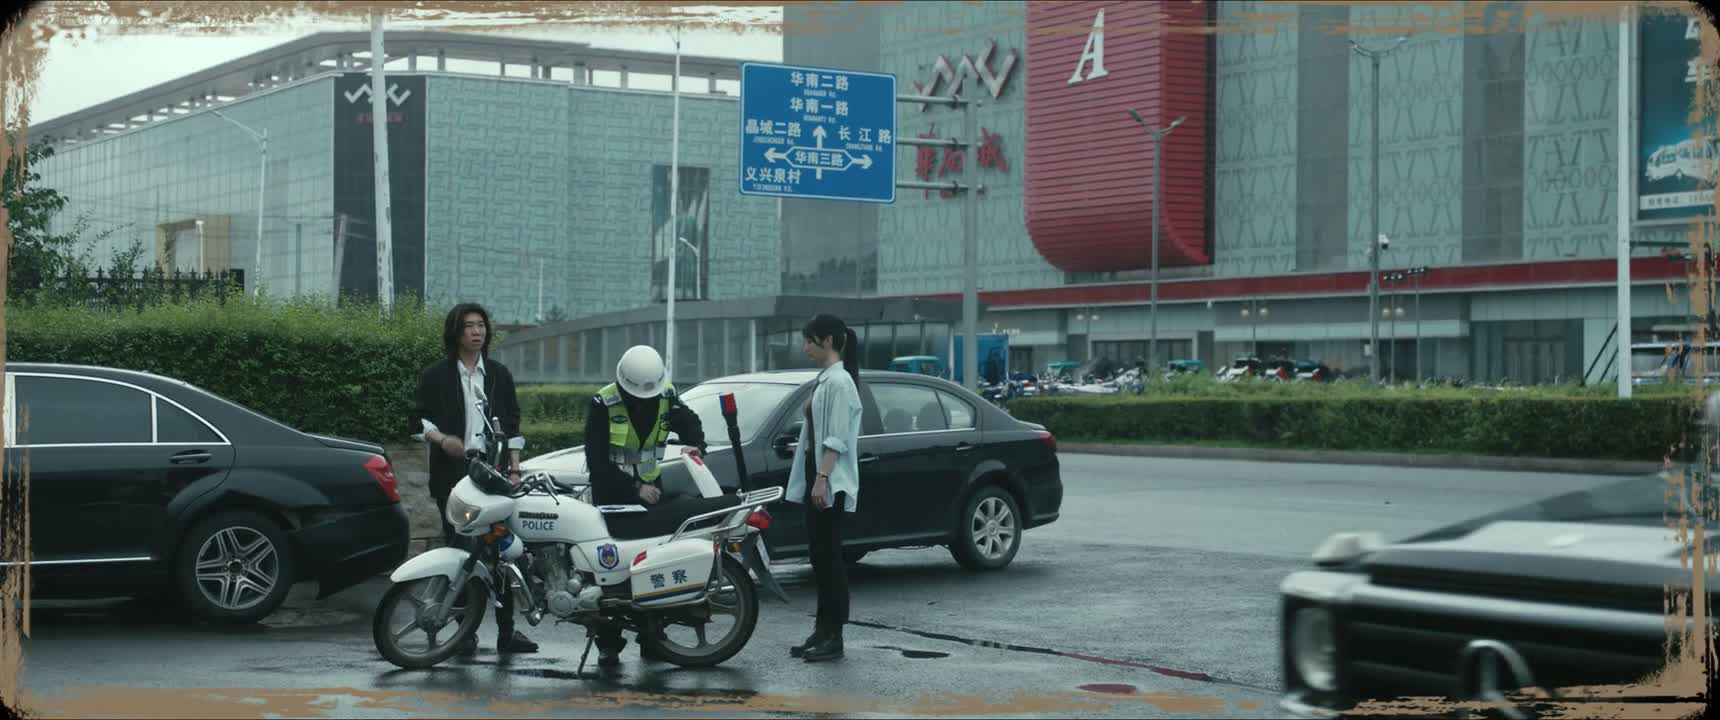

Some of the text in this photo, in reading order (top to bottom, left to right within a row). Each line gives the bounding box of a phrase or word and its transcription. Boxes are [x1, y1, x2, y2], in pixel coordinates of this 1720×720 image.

[1067, 8, 1108, 85] A
[790, 71, 849, 91] 华南二路
[790, 97, 849, 116] 华南一路
[745, 119, 802, 137] 晶城二路
[838, 126, 891, 144] 长江路
[795, 151, 844, 167] 华南三路
[745, 166, 801, 184] 义兴泉村
[522, 520, 555, 531] POLICE
[650, 569, 688, 589] 警察
